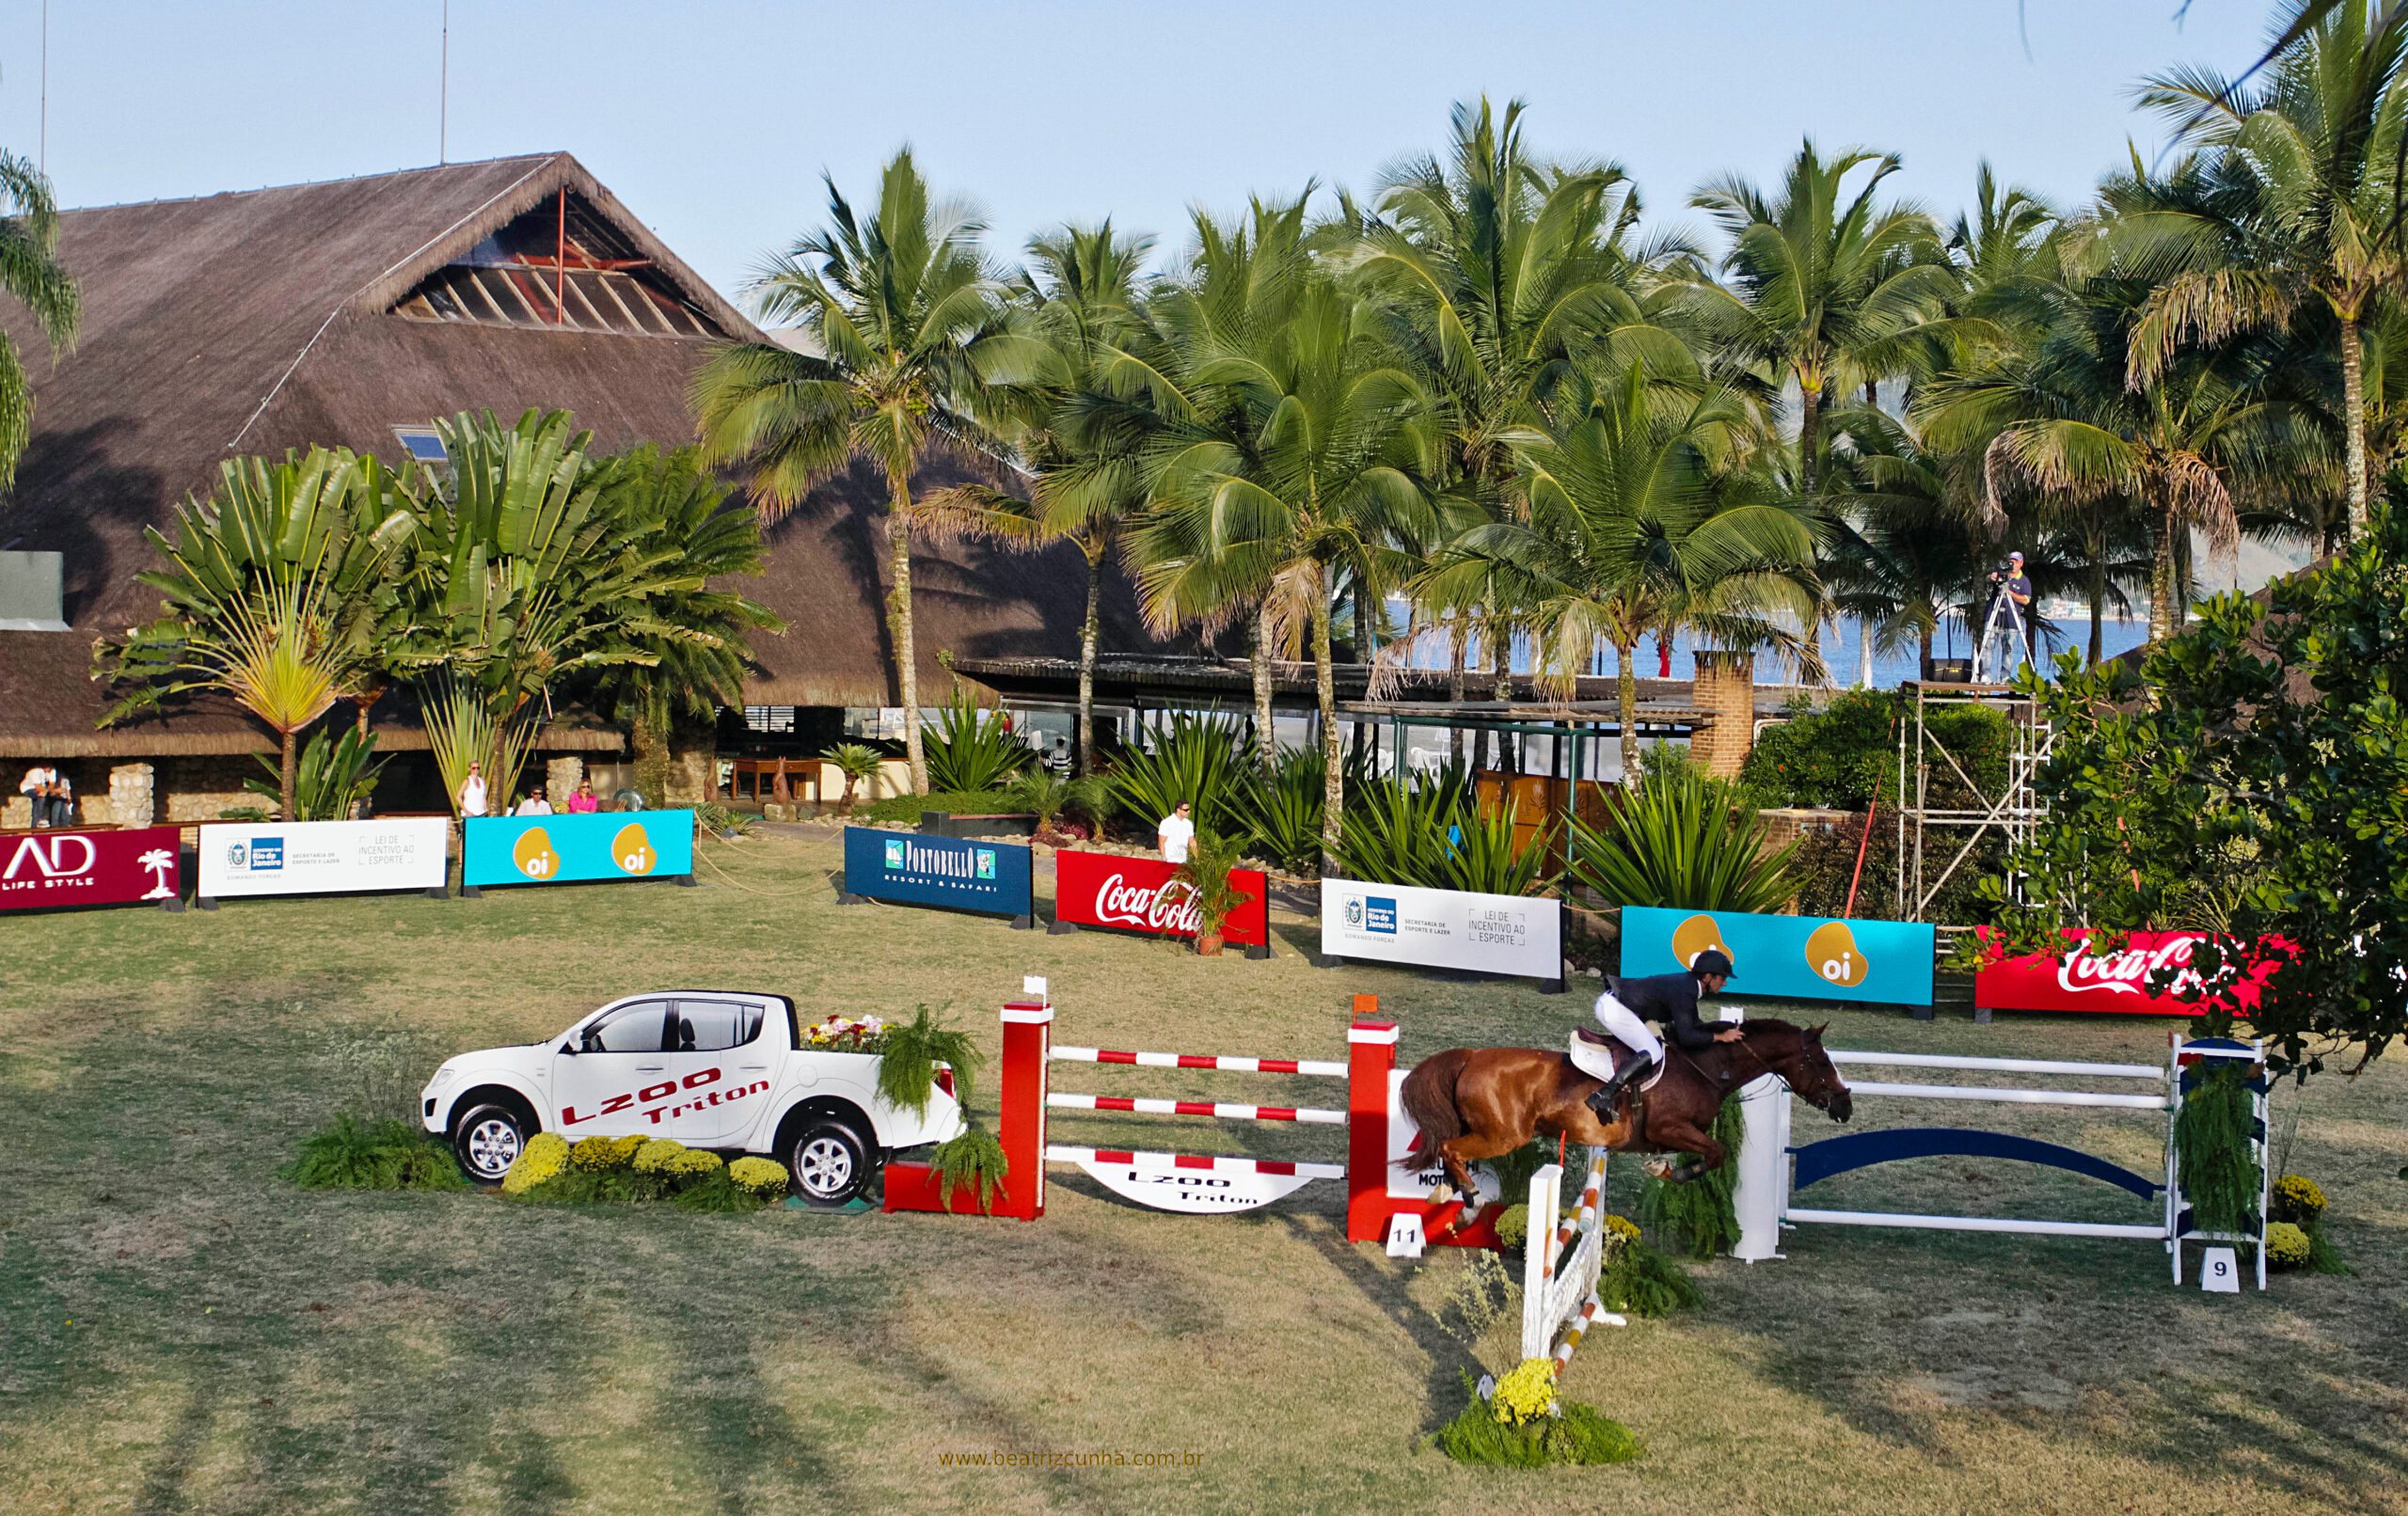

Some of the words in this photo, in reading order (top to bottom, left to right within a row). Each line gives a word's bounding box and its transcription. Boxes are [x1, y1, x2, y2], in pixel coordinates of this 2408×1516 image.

[374, 836, 387, 845] LEI
[388, 835, 399, 844] DE
[358, 846, 402, 855] INCENTIVO
[403, 845, 415, 854] AO
[369, 855, 404, 865] ESPORTE
[527, 851, 548, 876] oi
[624, 846, 645, 871] oi
[906, 840, 974, 879] PORTOBELLO
[2, 880, 36, 891] LIFE
[44, 877, 94, 888] STYLE
[884, 875, 931, 885] RESORT
[951, 882, 997, 892] SAFARI
[1095, 873, 1204, 931] Coca-Cola
[1367, 912, 1380, 921] Rio
[1404, 919, 1437, 927] SECRETARIA
[1484, 910, 1497, 921] LEI
[1497, 911, 1509, 922] DE
[1368, 921, 1395, 930] Janeiro
[1468, 921, 1512, 933] INCENTIVO
[1513, 924, 1526, 935] AO
[1479, 932, 1515, 945] ESPORTE
[1822, 952, 1851, 982] oi
[642, 1081, 769, 1124] Triton
[1178, 1192, 1258, 1205] Triton
[1393, 1229, 1416, 1244] 11
[2214, 1262, 2226, 1276] 9
